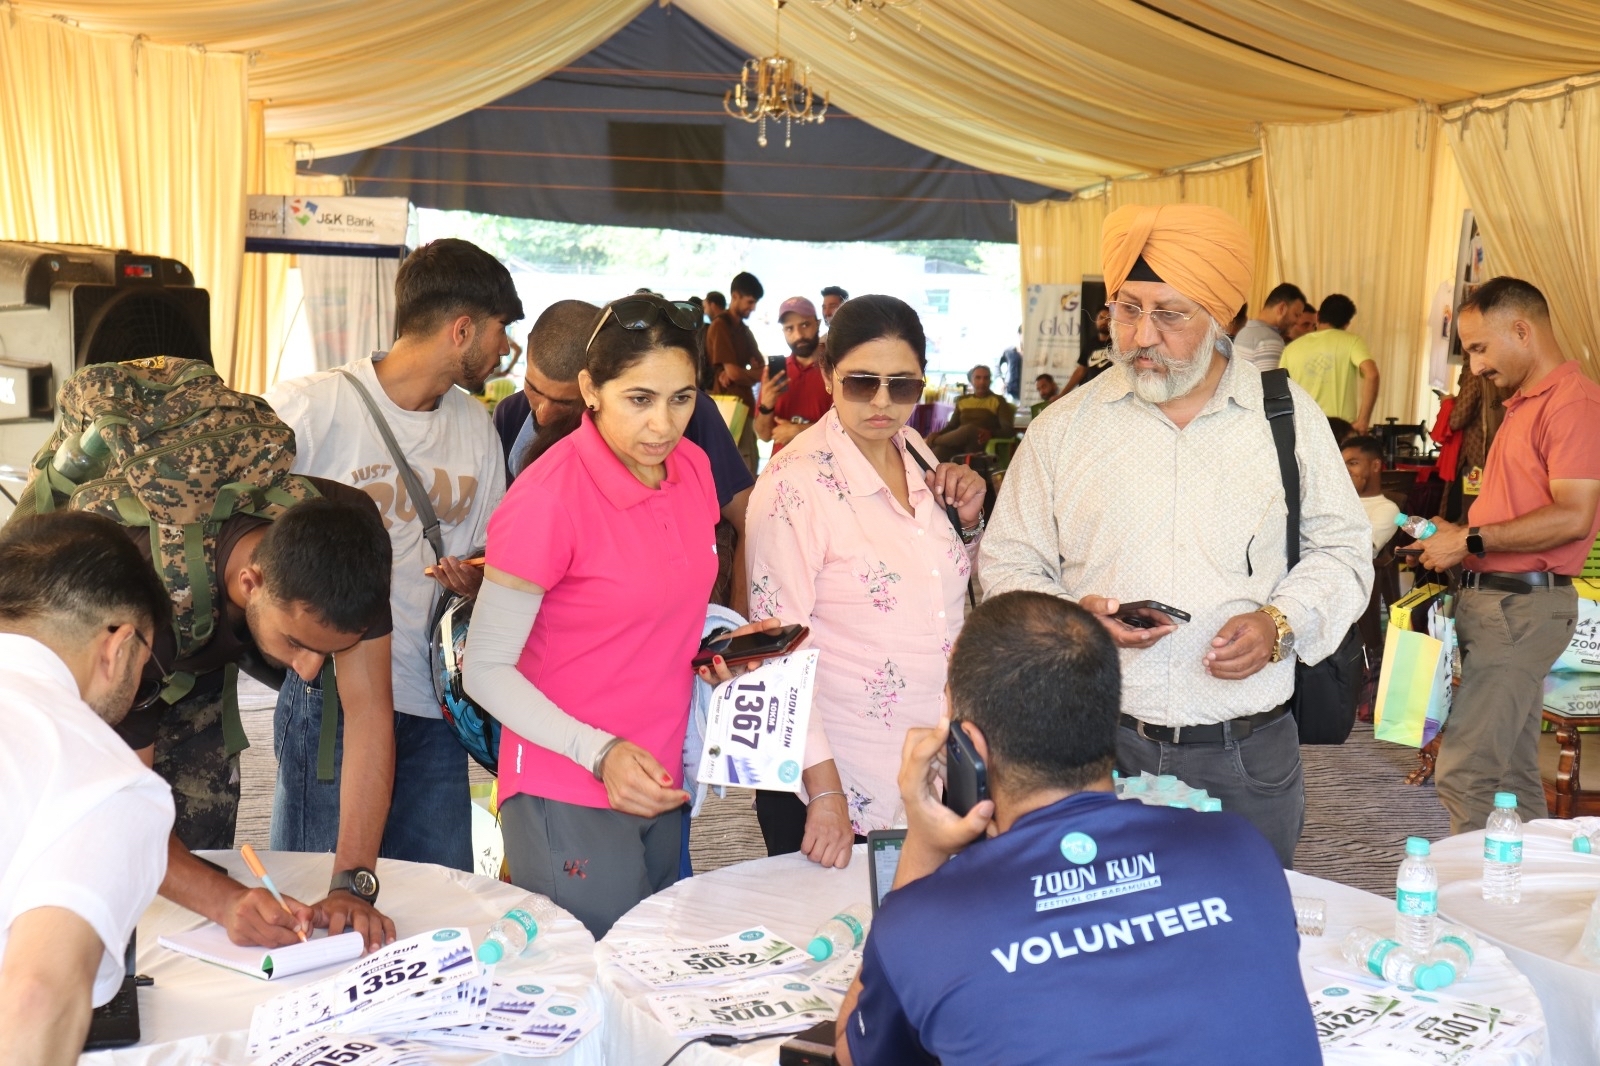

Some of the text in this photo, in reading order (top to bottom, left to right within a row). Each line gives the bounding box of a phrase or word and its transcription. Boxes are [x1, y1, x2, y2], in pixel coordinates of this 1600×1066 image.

[249, 208, 278, 221] Bank
[316, 213, 375, 227] J&K Bank
[351, 464, 392, 485] JUST
[731, 681, 766, 749] 1367
[768, 701, 778, 726] 10KM
[784, 686, 798, 748] ZOON RUN
[1031, 852, 1156, 897] ZOON RUN
[1038, 895, 1082, 910] FESTIVAL
[1086, 892, 1099, 900] OF
[991, 897, 1232, 973] VOLUNTEER
[393, 944, 418, 955] RUN
[683, 952, 766, 971] 5052
[343, 961, 428, 1003] 1352
[709, 1000, 796, 1022] 5001
[1422, 1012, 1487, 1046] 5401
